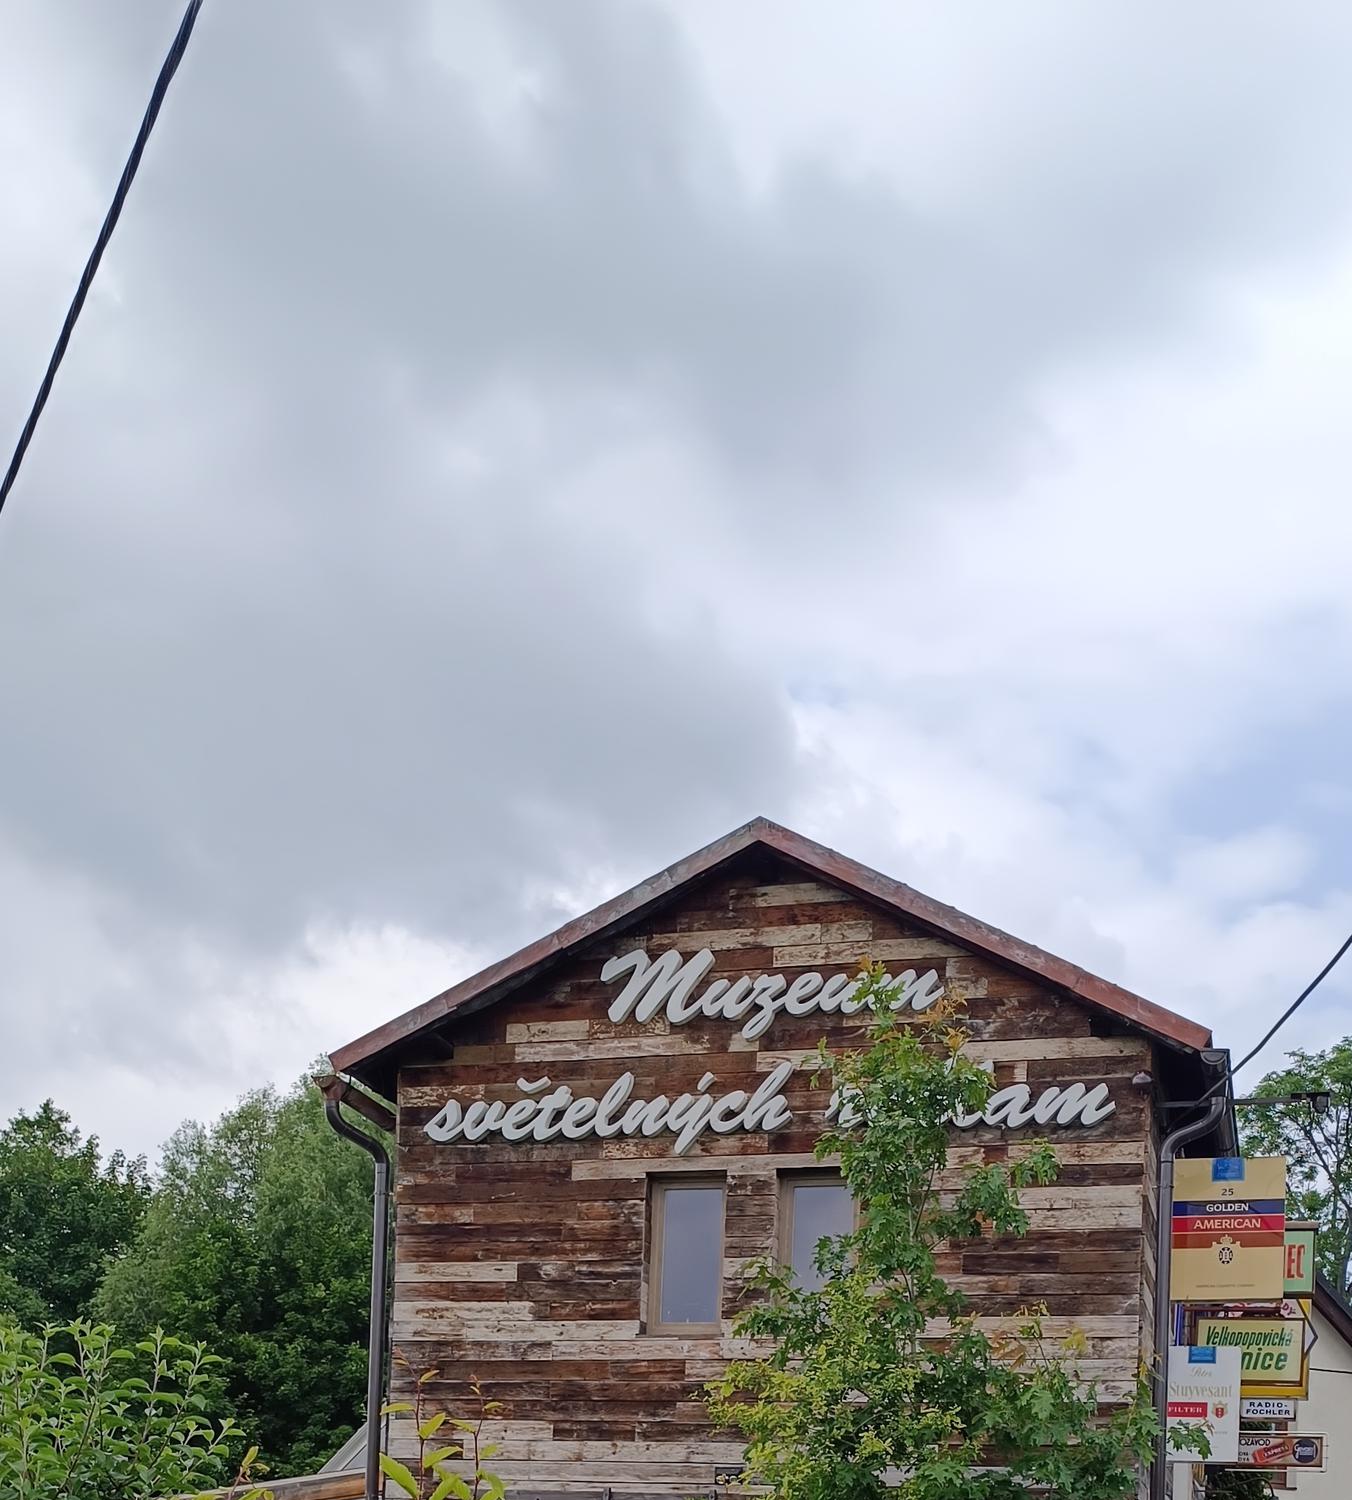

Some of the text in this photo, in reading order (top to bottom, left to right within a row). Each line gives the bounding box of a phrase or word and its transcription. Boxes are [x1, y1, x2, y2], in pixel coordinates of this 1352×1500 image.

[601, 948, 945, 1041] Muzeum
[423, 1060, 792, 1155] světelných
[1221, 1188, 1234, 1196] 25
[1206, 1203, 1249, 1213] GOLDEN
[1193, 1218, 1261, 1229] AMERICAN
[1168, 1381, 1232, 1399] Stuyvesant
